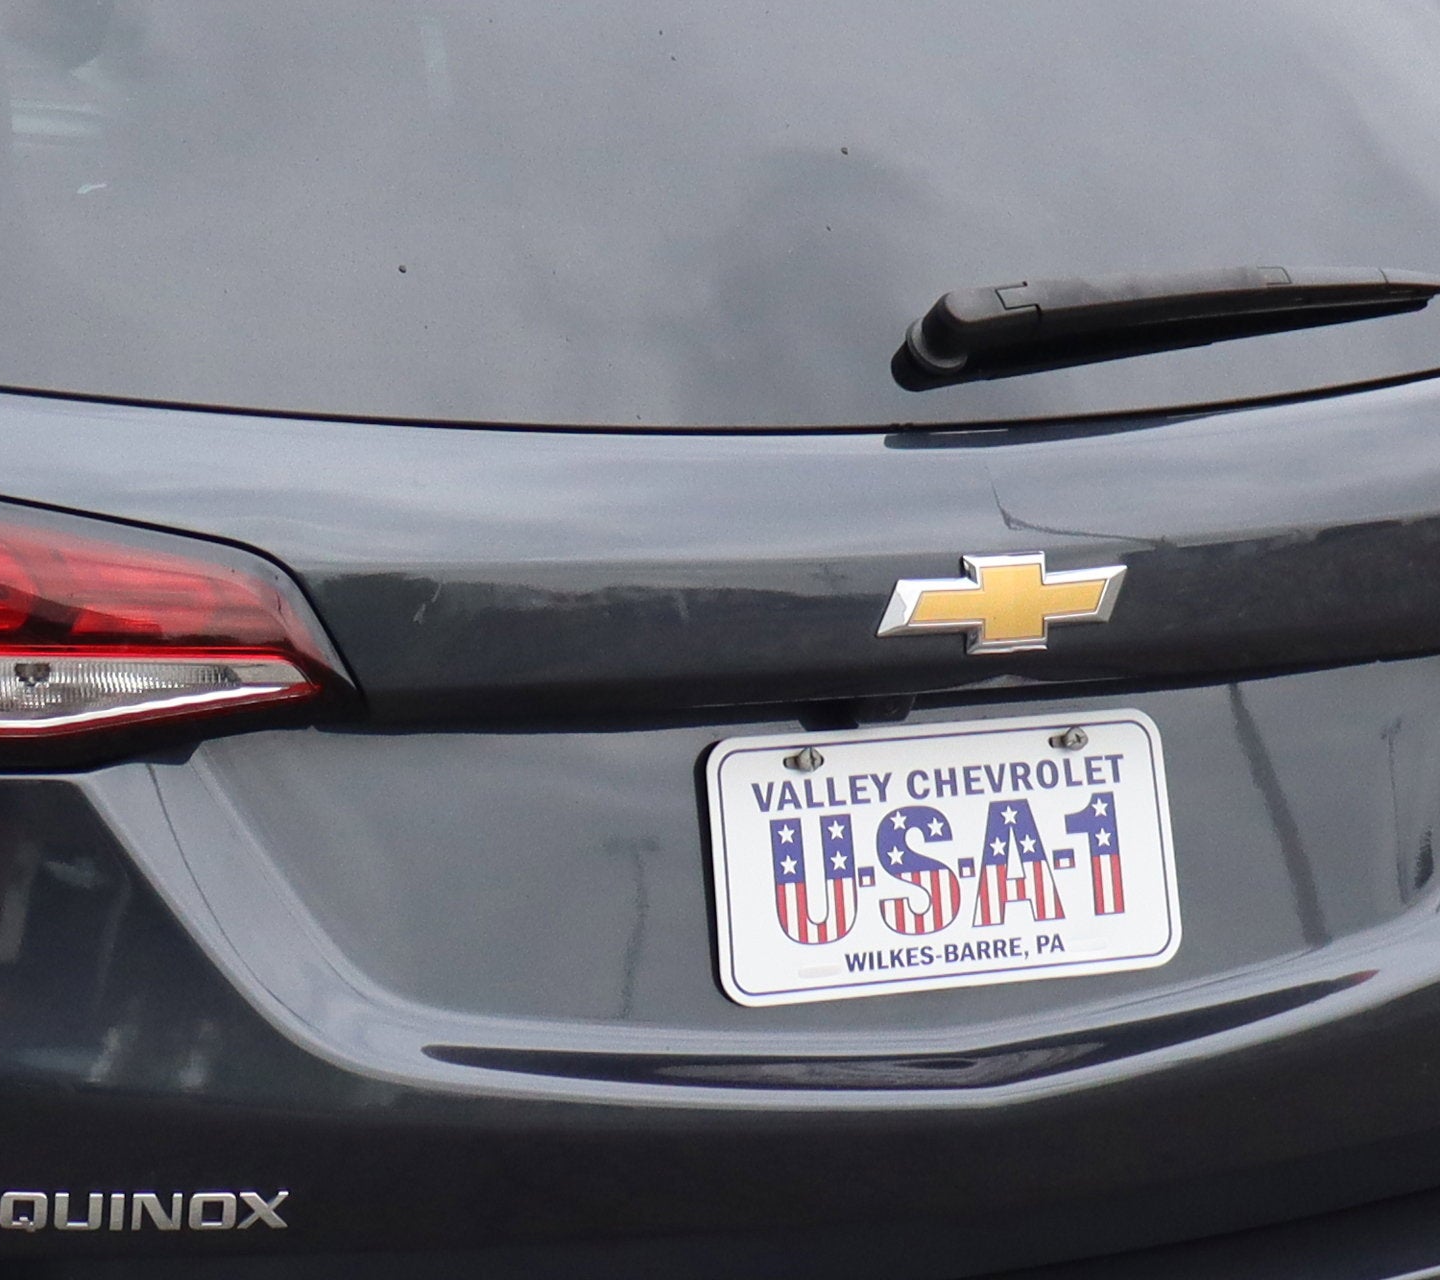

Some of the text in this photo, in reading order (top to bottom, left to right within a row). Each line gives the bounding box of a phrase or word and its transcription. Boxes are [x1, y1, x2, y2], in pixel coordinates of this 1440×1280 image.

[750, 753, 1125, 814] VALLEY CHEVROLET
[844, 933, 1066, 973] WILKES-BARRE, PA
